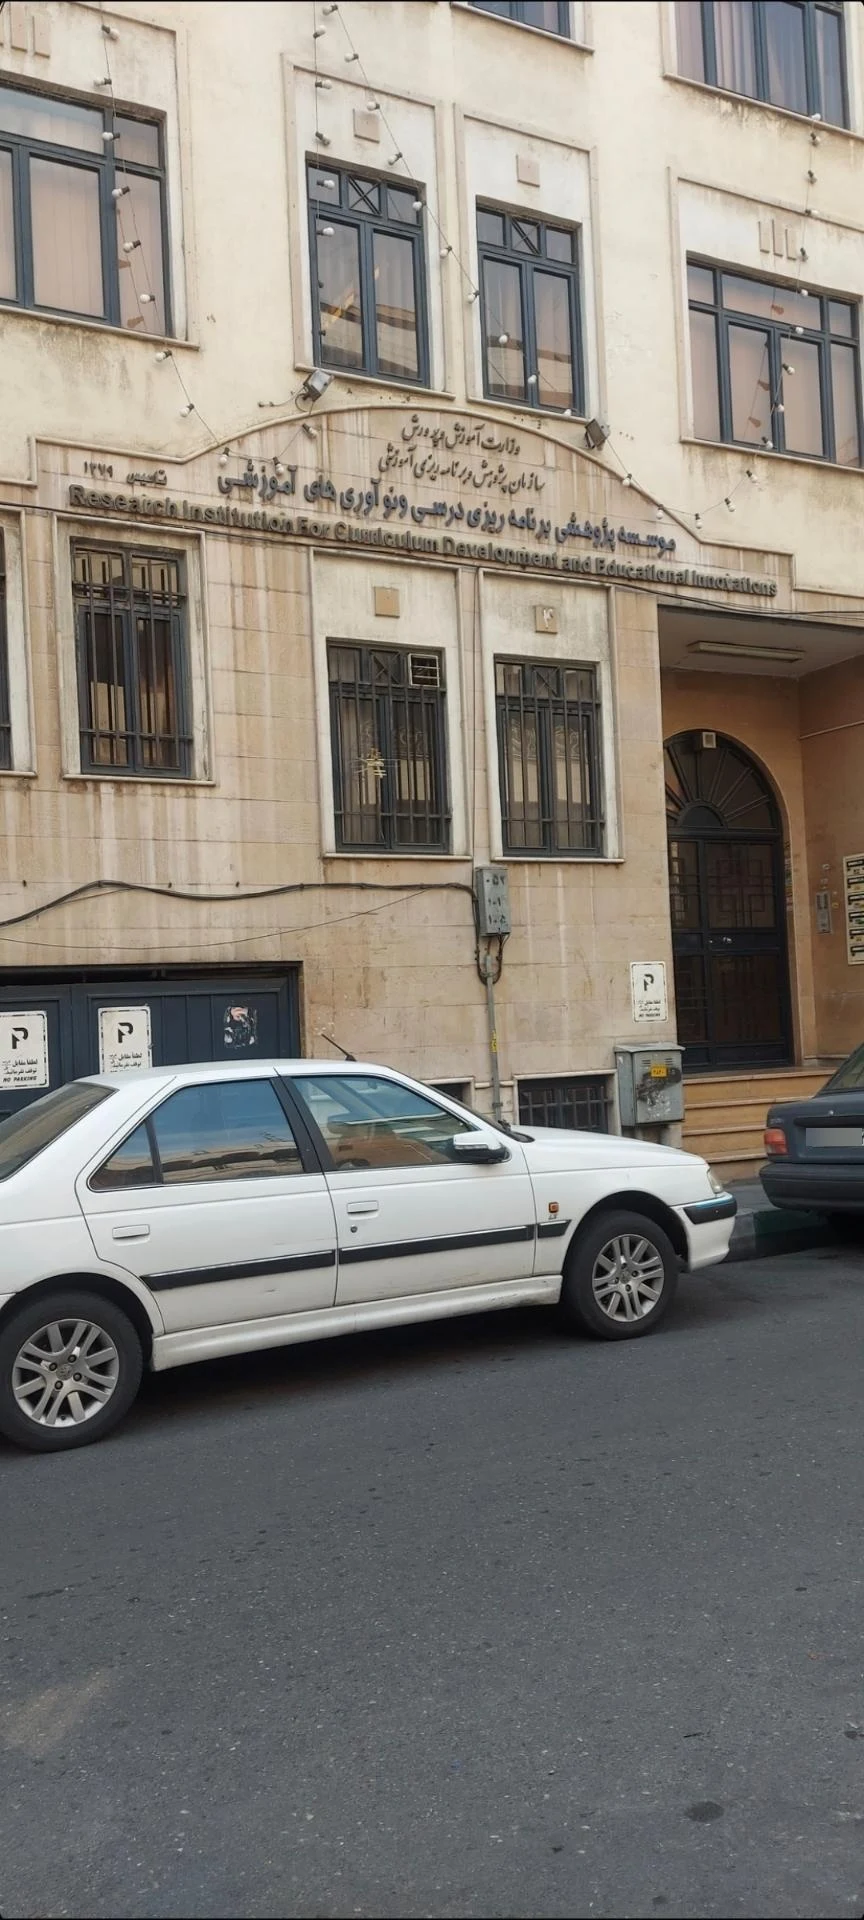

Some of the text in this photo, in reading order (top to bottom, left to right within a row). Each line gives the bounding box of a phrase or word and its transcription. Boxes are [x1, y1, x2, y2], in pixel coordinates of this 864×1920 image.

[445, 422, 485, 449] آموزش
[481, 436, 521, 455] وزارت
[378, 442, 417, 473] آموزشی
[217, 458, 298, 501] آموزشی
[303, 474, 337, 503] های
[473, 459, 507, 493] پژوهش
[508, 471, 546, 494] سازمان
[410, 500, 464, 527] درسی
[68, 484, 778, 598] Research Institution For Curriculum Development and Educational Innovations
[555, 511, 616, 552] پژوهشی
